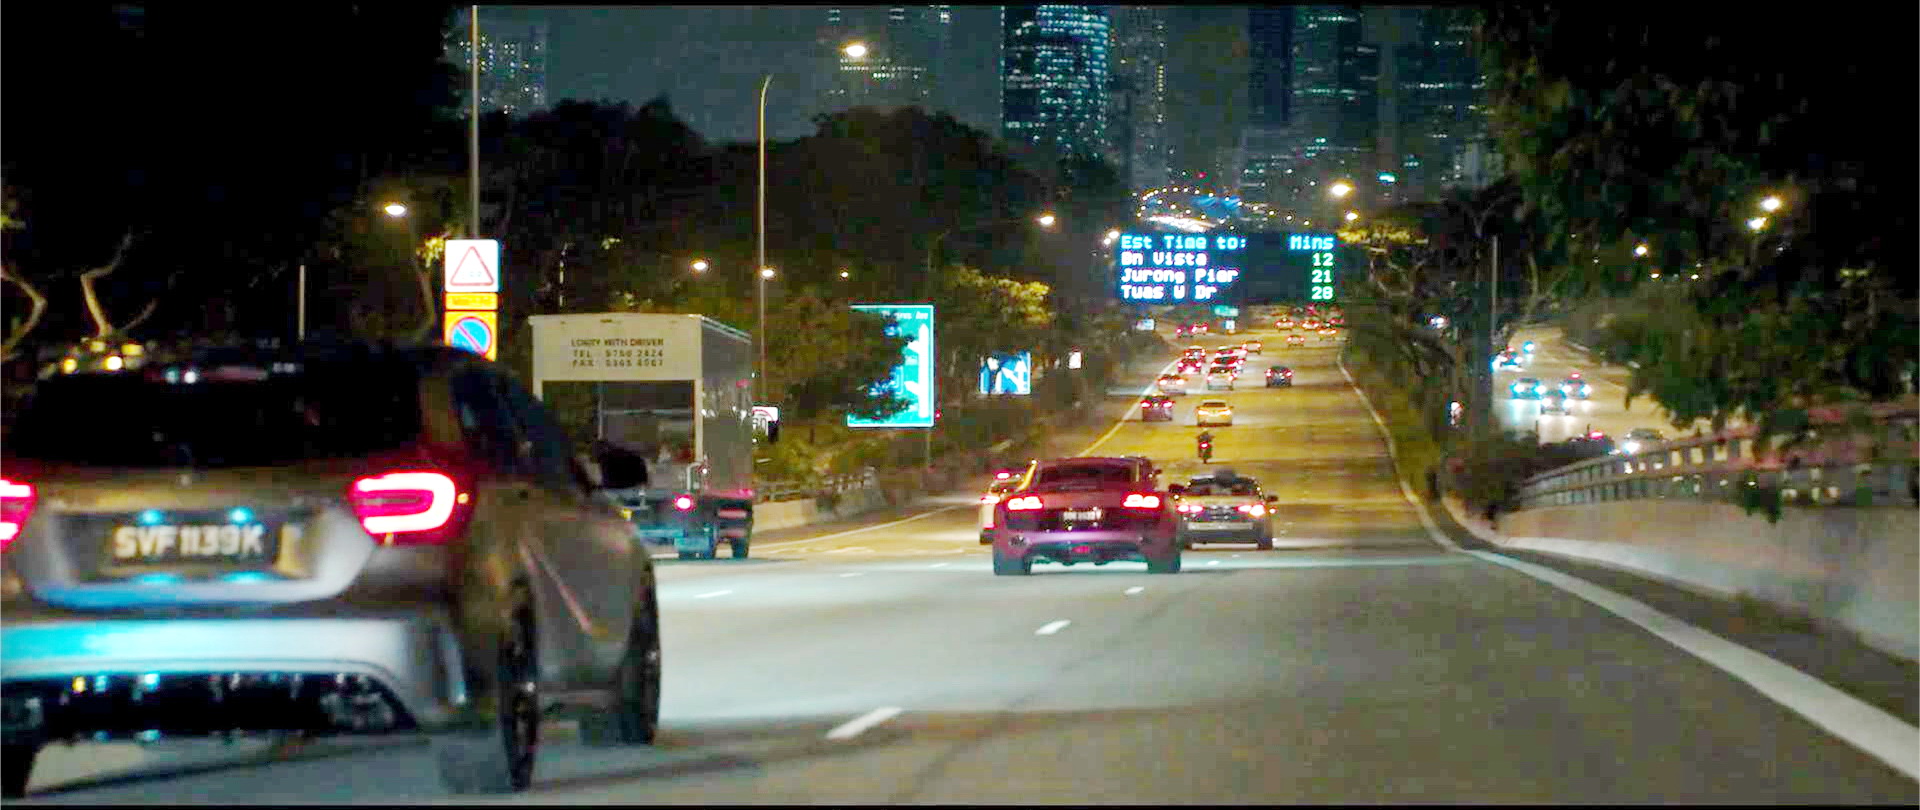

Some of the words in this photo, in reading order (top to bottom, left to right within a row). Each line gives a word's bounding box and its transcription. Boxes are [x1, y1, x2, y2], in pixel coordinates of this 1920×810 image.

[1121, 235, 1152, 249] Est
[1163, 235, 1207, 249] Time
[1216, 235, 1247, 250] to:
[1289, 235, 1334, 250] Mins
[1121, 252, 1144, 266] Bn
[1153, 252, 1207, 266] Vista
[1312, 252, 1334, 266] 12
[1121, 268, 1185, 284] Jurong
[1194, 268, 1238, 282] Pier
[1311, 269, 1332, 283] 21
[1121, 285, 1164, 299] Tuas
[1194, 285, 1217, 299] Dr
[1311, 286, 1333, 299] 28
[604, 338, 628, 346] WITH
[630, 338, 664, 346] DRIVER
